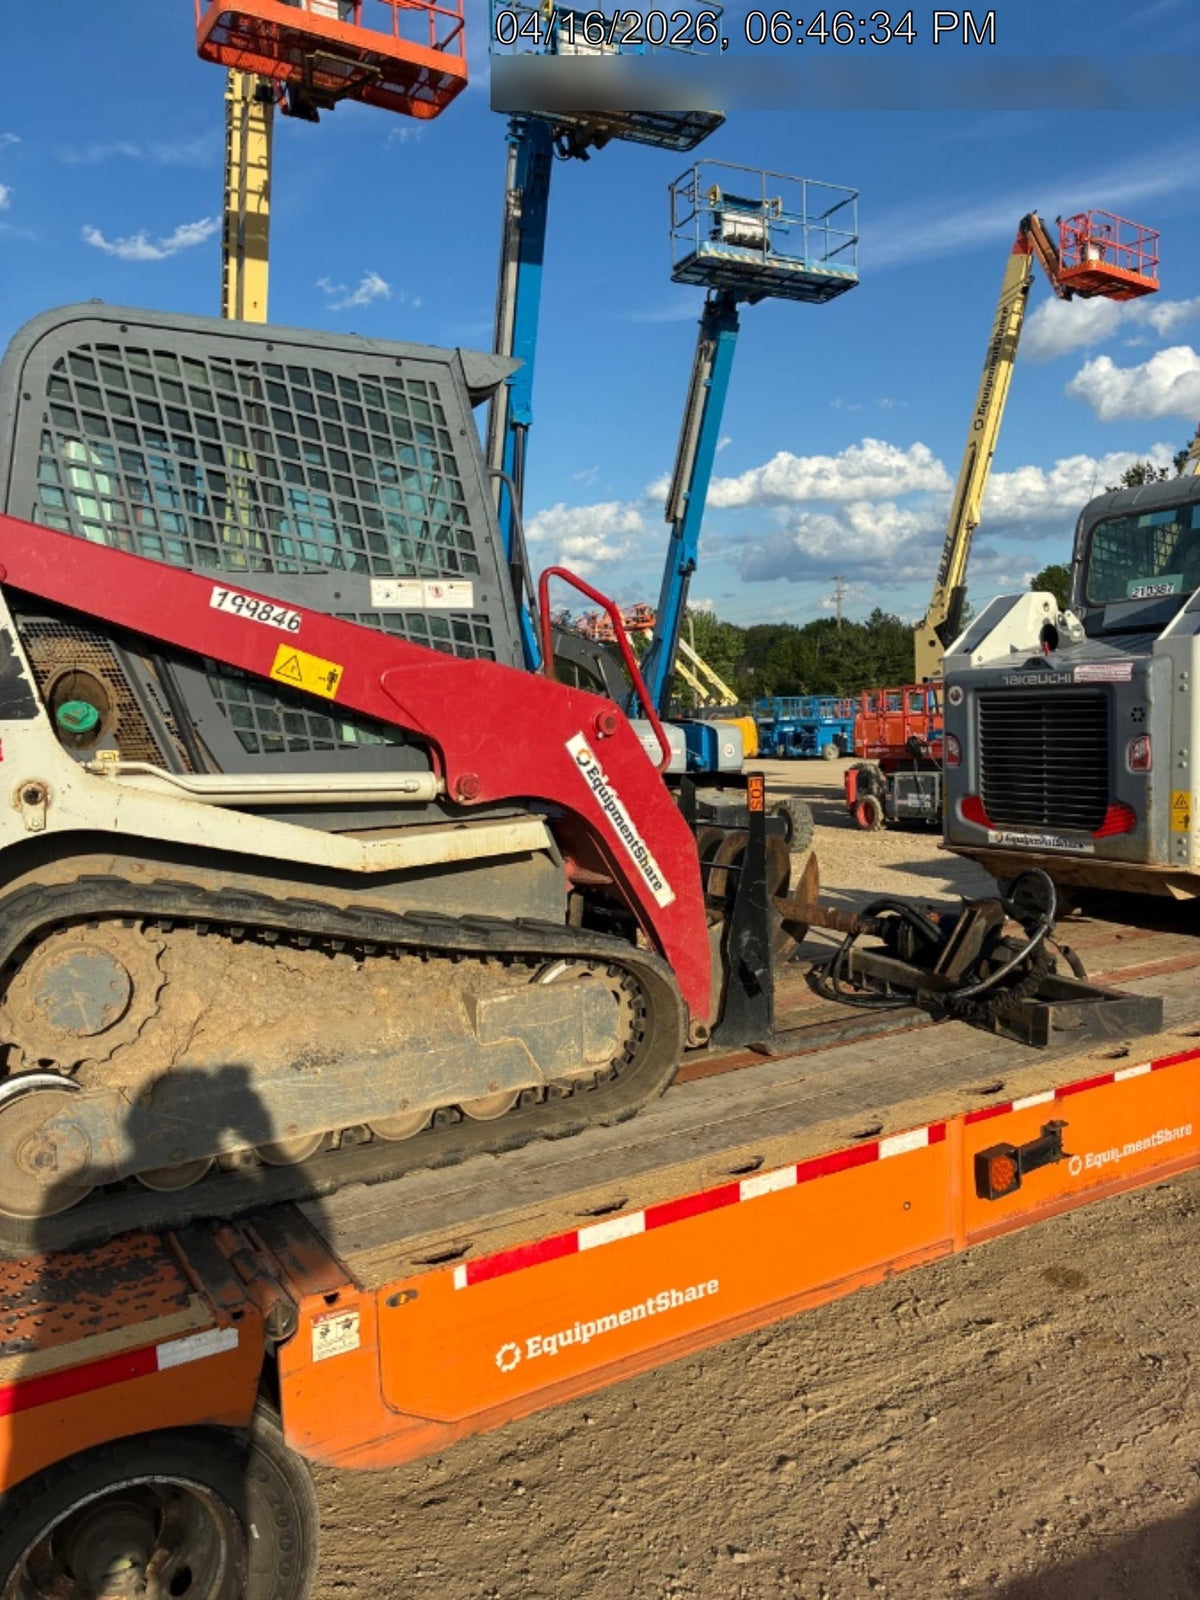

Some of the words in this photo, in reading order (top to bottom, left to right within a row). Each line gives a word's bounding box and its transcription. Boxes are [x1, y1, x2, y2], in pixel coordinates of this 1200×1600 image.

[217, 590, 300, 631] 199846
[586, 766, 663, 892] EquipmentShare
[525, 1278, 720, 1360] EquipmentShare
